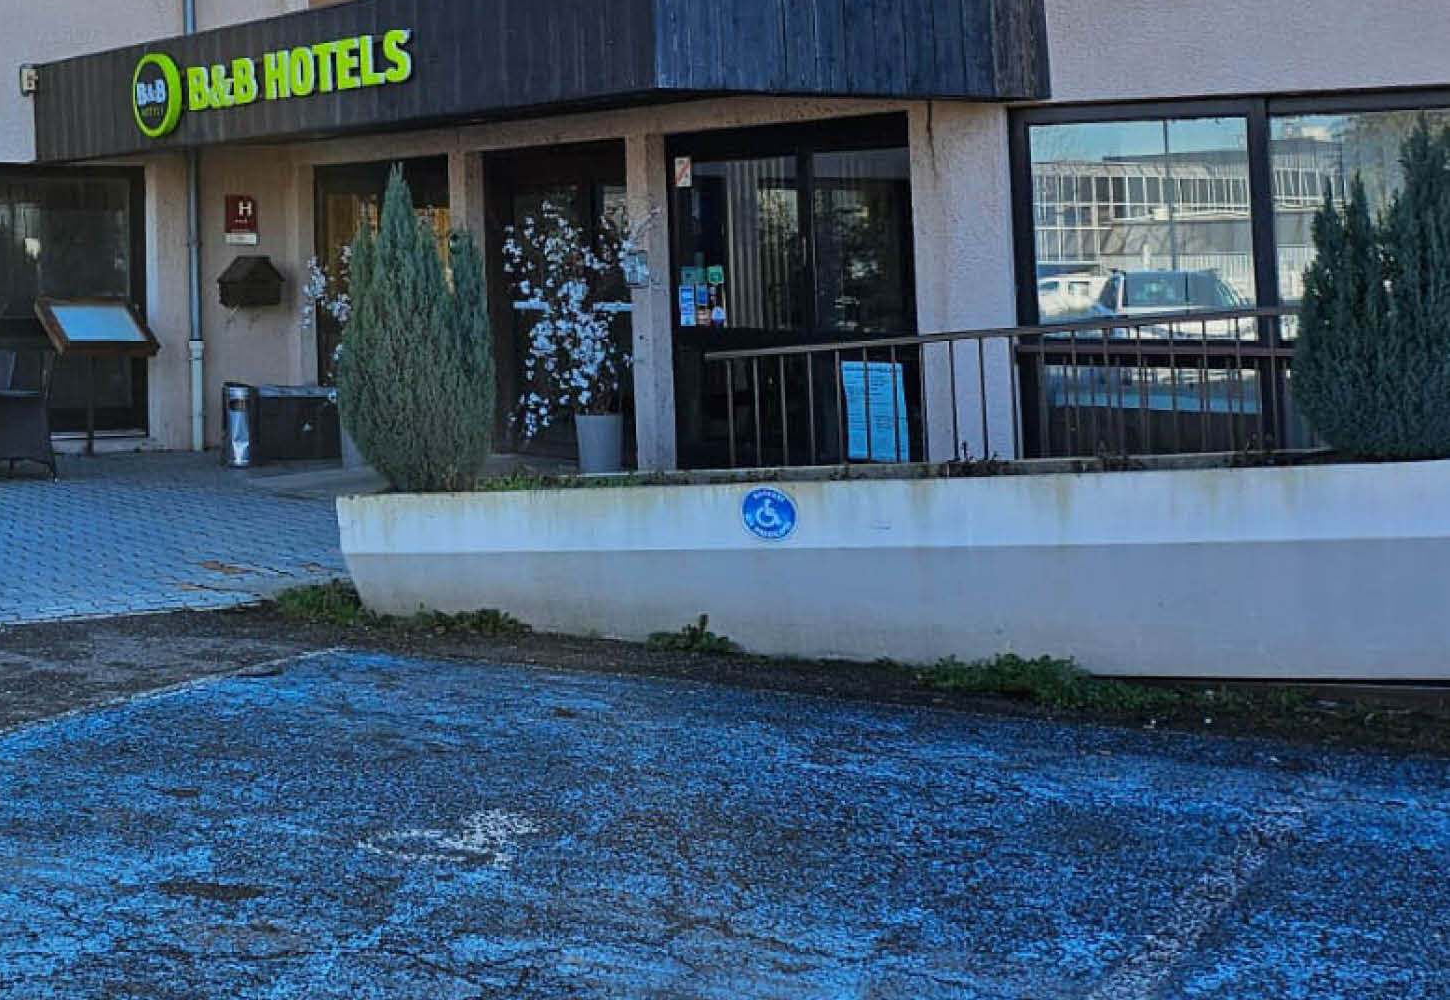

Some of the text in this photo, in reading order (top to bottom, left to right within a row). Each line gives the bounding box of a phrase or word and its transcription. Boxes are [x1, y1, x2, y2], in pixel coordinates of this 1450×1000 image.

[187, 29, 412, 111] B&B HOTELS
[238, 200, 252, 216] H
